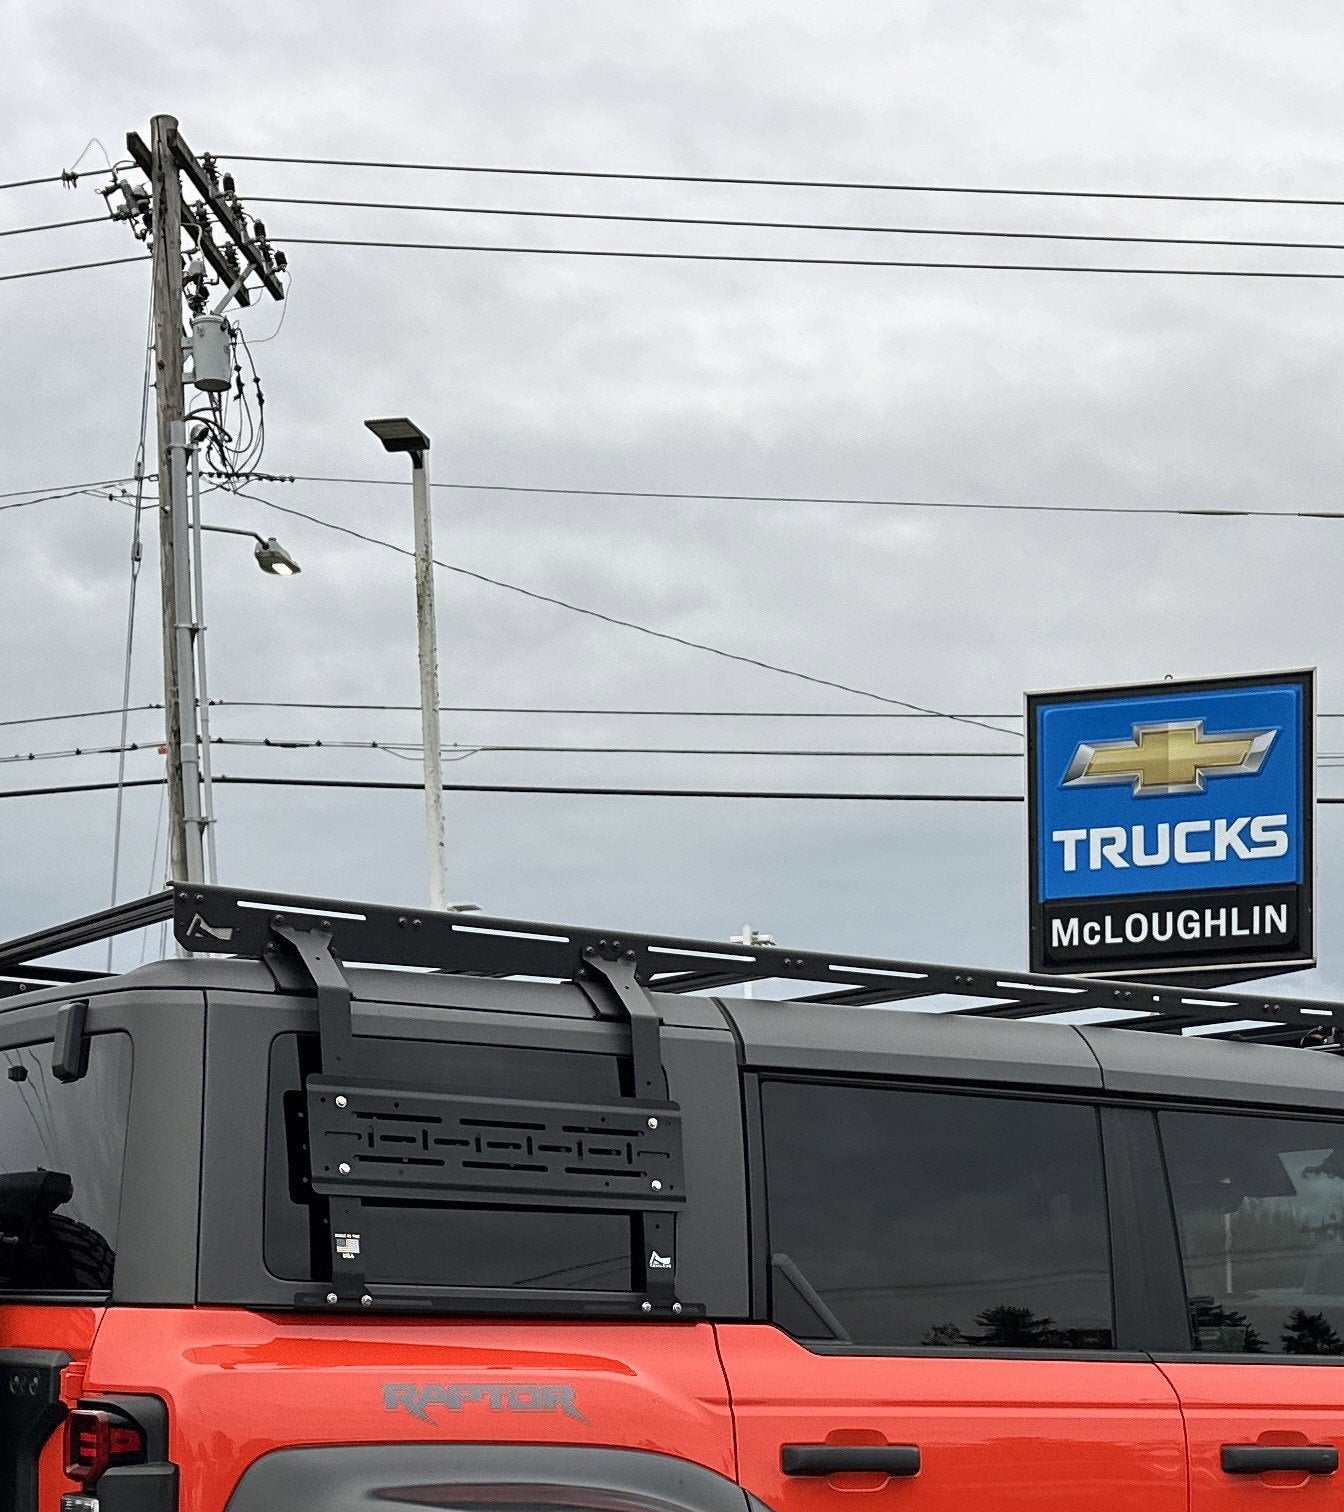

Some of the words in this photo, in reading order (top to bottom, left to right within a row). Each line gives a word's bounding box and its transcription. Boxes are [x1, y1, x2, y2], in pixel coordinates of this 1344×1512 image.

[1052, 813, 1289, 872] TRUCKS
[1051, 903, 1288, 948] McLOUGHLIN
[382, 1382, 593, 1428] RAPTOR
